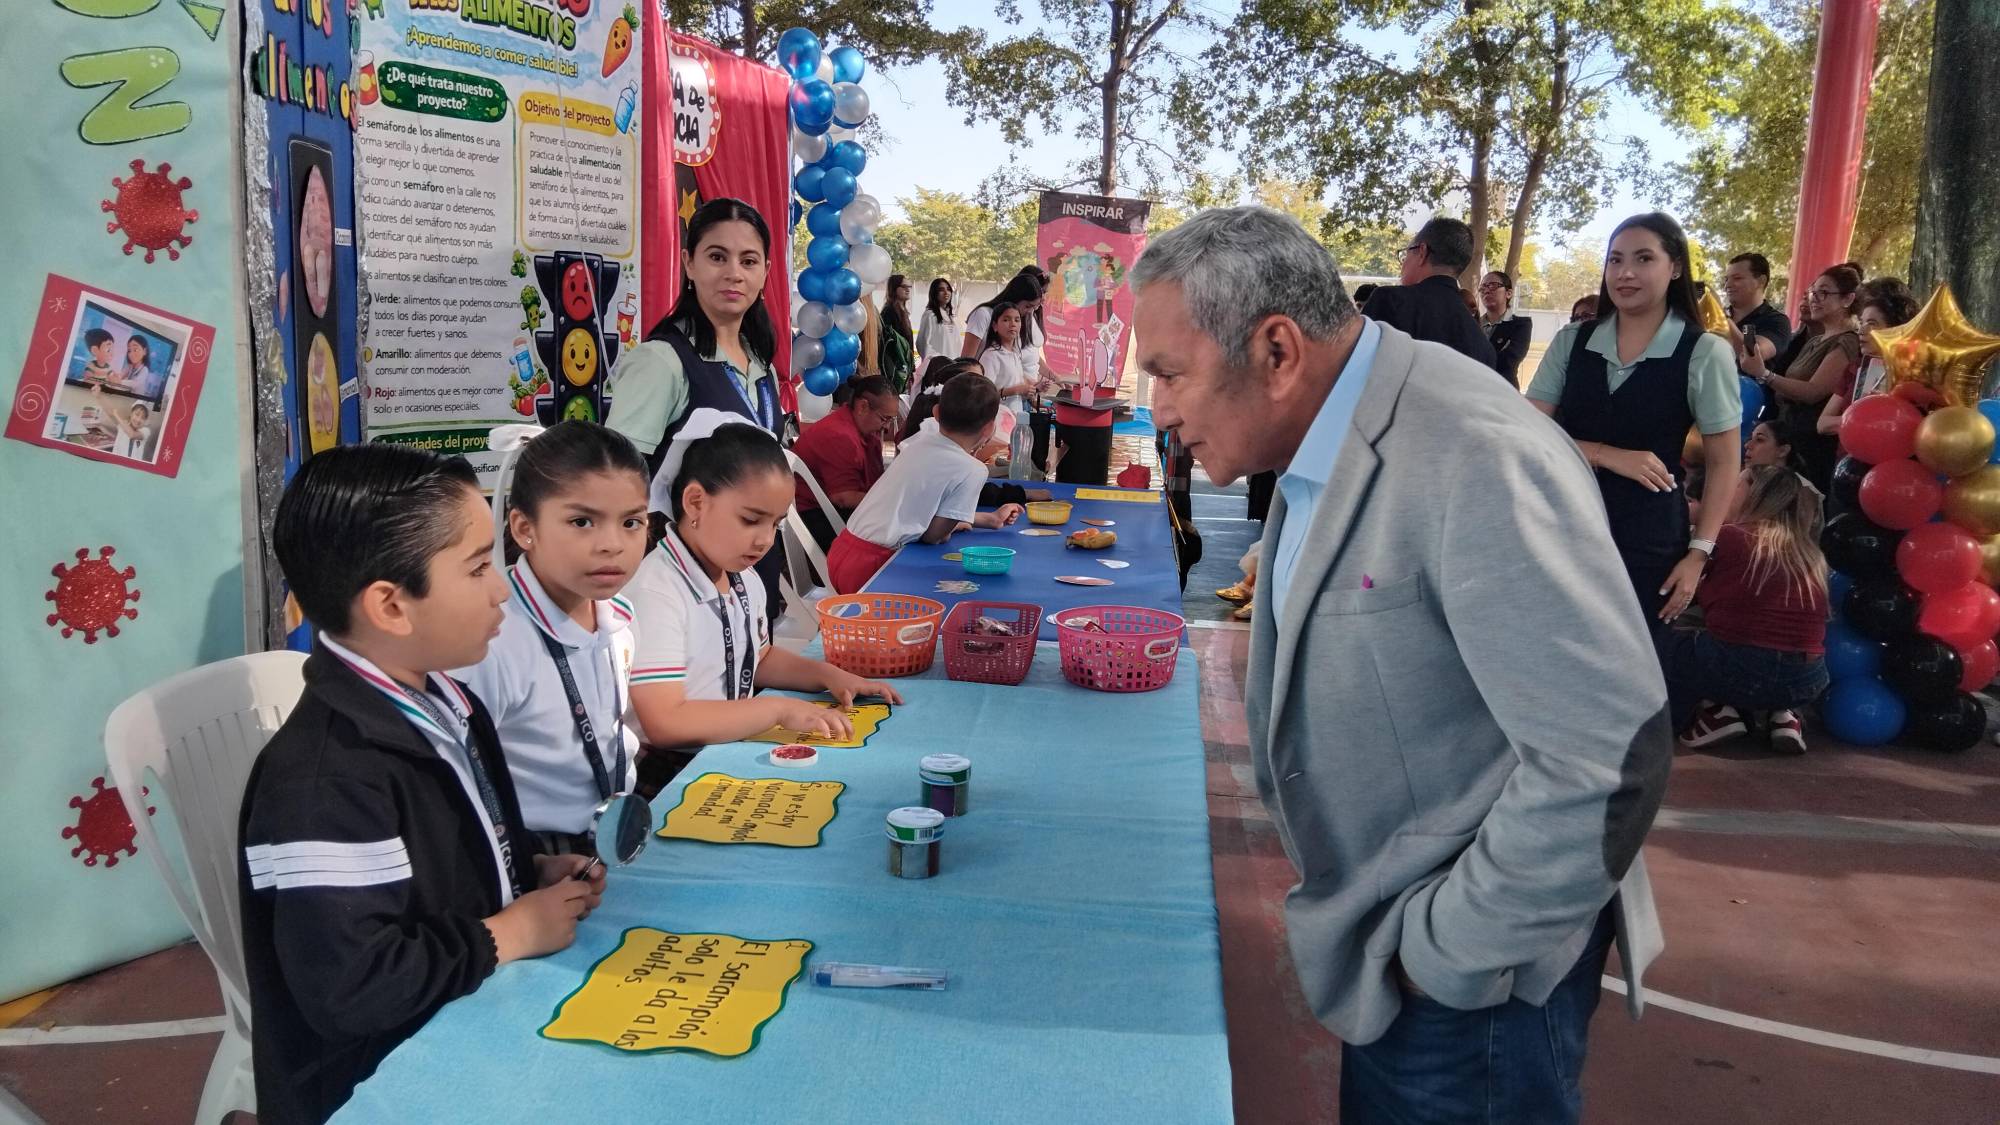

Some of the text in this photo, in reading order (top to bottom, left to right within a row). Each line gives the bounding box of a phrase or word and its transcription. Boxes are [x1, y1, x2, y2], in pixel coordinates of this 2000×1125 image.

[461, 0, 576, 50] ALIMENTOS
[406, 25, 578, 78] ¡Aprendemos a comer saludble!
[387, 66, 493, 98] ¿De qué trata nuestro
[417, 93, 468, 110] proyecto?
[525, 99, 560, 117] Objetivo
[576, 112, 610, 126] proyecto
[366, 120, 406, 134] semáforo
[407, 124, 417, 135] de
[420, 125, 432, 136] los
[435, 128, 474, 143] alimentos
[476, 137, 484, 146] es
[486, 137, 500, 148] una
[384, 140, 500, 164] sencilla y divertida de aprender
[530, 131, 558, 145] Promover
[568, 140, 609, 154] conocimiento
[616, 146, 622, 156] la
[366, 154, 476, 176] elegir mejor lo que comemos.
[556, 153, 563, 162] de
[579, 156, 622, 170] alimentación
[530, 165, 562, 178] saludable
[594, 174, 600, 182] el
[614, 177, 622, 185] del
[371, 178, 496, 200] como un semáforo en la calle nos
[530, 181, 558, 192] semáforo
[560, 186, 568, 194] de
[612, 193, 624, 202] para
[383, 195, 412, 208] cuándo
[414, 200, 444, 211] avanzar
[529, 198, 540, 208] que
[543, 198, 552, 207] los
[582, 202, 618, 216] identifiquen
[1062, 202, 1124, 220] INSPIRAR
[372, 213, 496, 234] colores del semáforo nos ayudan
[529, 212, 537, 222] de
[538, 212, 558, 222] forma
[581, 218, 607, 229] divertida
[367, 228, 493, 249] identificar alimentos son más
[529, 228, 560, 240] alimentos
[562, 232, 573, 240] son
[398, 252, 479, 268] para nuestro cuerpo.
[374, 269, 410, 282] alimentos
[412, 274, 421, 282] se
[424, 272, 457, 284] clasifican
[458, 277, 468, 285] en
[470, 277, 482, 286] tres
[374, 292, 400, 304] Verde:
[403, 294, 442, 306] alimentos
[442, 298, 458, 310] que
[460, 297, 492, 309] podemos
[374, 310, 394, 321] todos
[398, 310, 408, 321] los
[430, 313, 458, 324] porque
[460, 313, 486, 325] ayudan
[375, 329, 380, 337] a
[382, 329, 404, 338] crecer
[408, 326, 436, 338] fuertes
[438, 331, 442, 340] y
[376, 348, 502, 363] Amarillo: alimentos que debemos
[376, 366, 408, 376] consumir
[411, 366, 424, 374] con
[375, 386, 398, 400] Rojo:
[400, 386, 436, 396] alimentos
[438, 388, 450, 398] que
[462, 386, 482, 398] mejor
[484, 386, 504, 395] comer
[374, 404, 392, 414] solo
[395, 405, 404, 414] en
[406, 403, 442, 412] ocasiones
[445, 435, 490, 450] del proye
[740, 595, 750, 615] ICO
[724, 627, 732, 648] ICO
[741, 669, 752, 688] ICO
[580, 718, 595, 742] ICO
[766, 803, 808, 829] estoy
[736, 941, 770, 956] El
[616, 936, 683, 988] adultos.
[668, 971, 704, 984] le
[644, 988, 688, 1008] da
[634, 1014, 656, 1024] a
[614, 1029, 658, 1047] los
